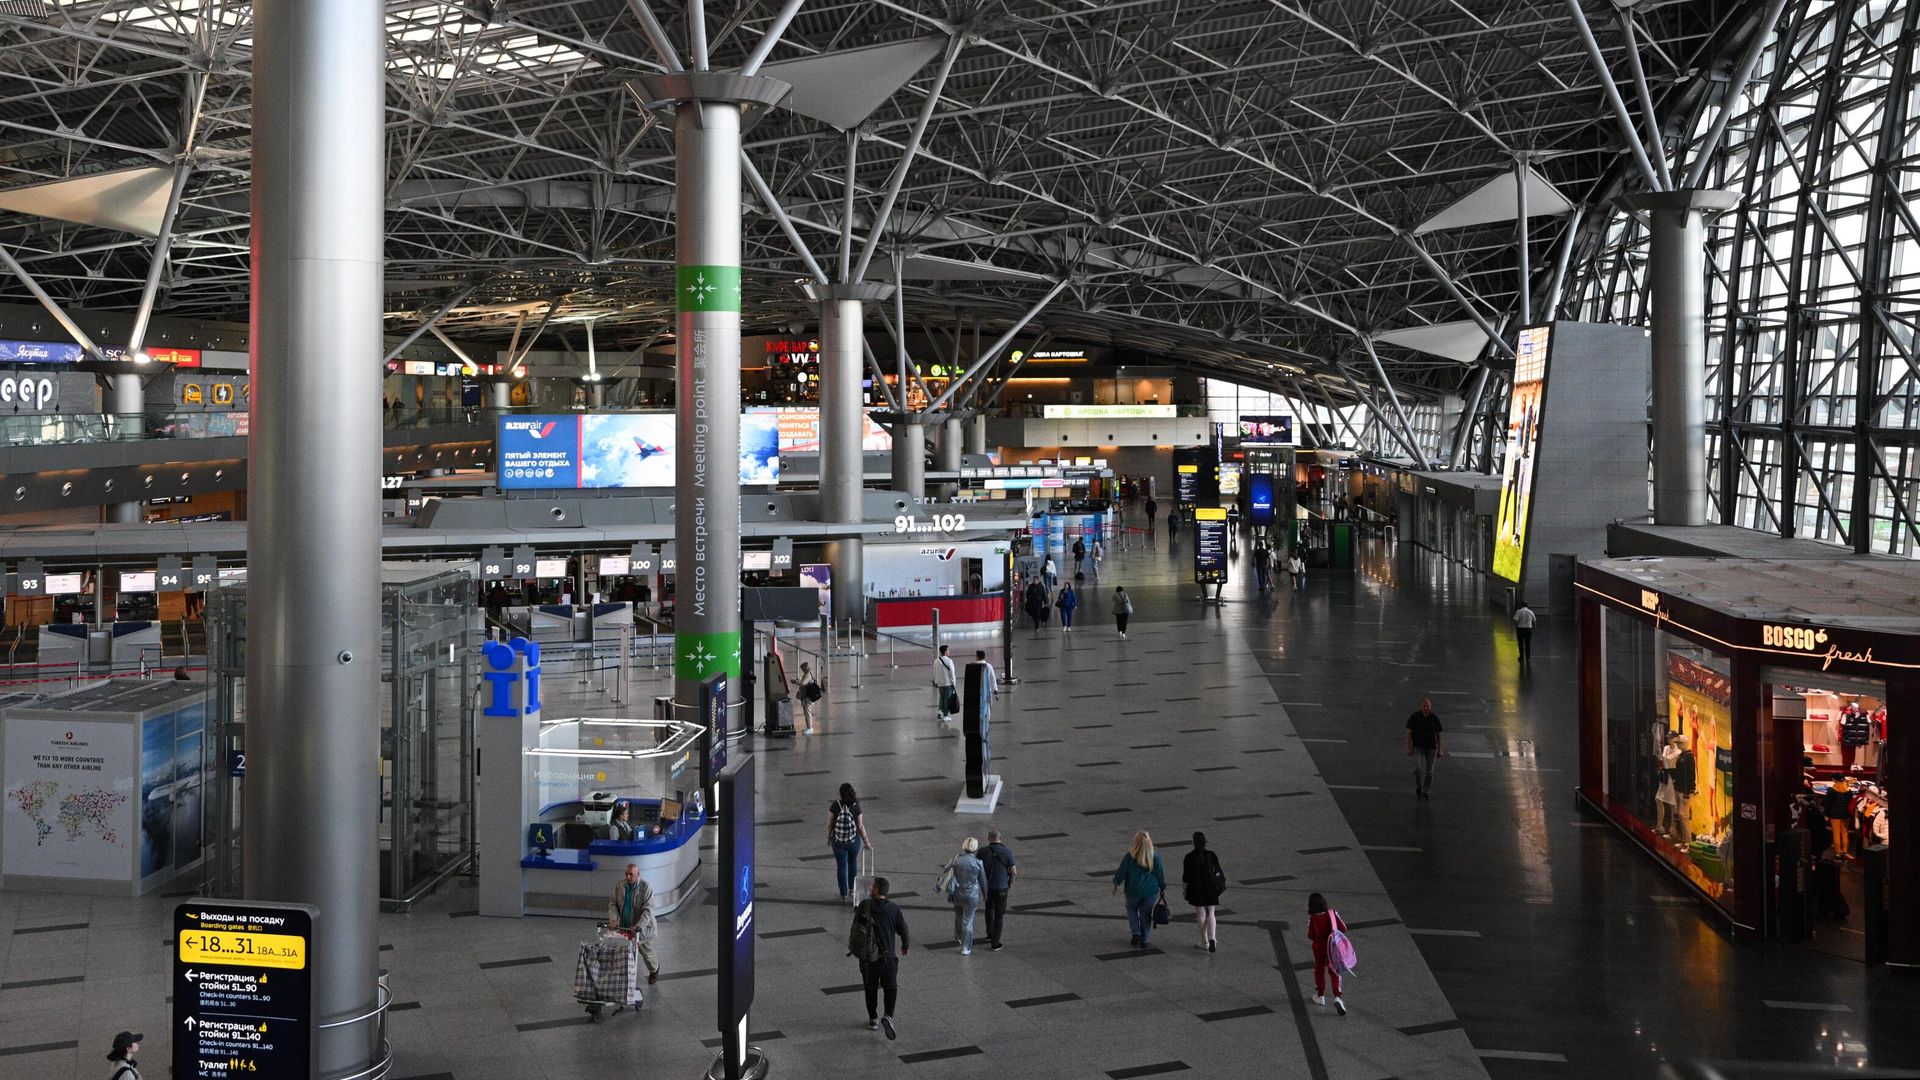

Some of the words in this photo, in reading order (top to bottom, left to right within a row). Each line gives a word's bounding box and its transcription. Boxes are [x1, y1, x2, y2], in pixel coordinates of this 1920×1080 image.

[791, 342, 807, 352] БАР
[693, 378, 708, 418] point
[505, 451, 531, 459] ПЯТЫЙ
[693, 424, 708, 487] Meeting
[696, 497, 708, 561] встречи
[774, 554, 791, 564] 102
[486, 564, 500, 574] 98
[516, 564, 530, 574] 99
[632, 560, 650, 570] 100
[22, 580, 38, 590] 93
[162, 576, 178, 586] 94
[694, 566, 705, 616] Место
[1762, 624, 1815, 650] BOSCO
[1822, 644, 1874, 672] fresh
[200, 912, 234, 922] Выходы
[249, 916, 285, 926] посадку
[200, 922, 226, 930] Boarding
[200, 936, 254, 954] 18...31
[200, 972, 256, 984] Регистрация,
[200, 982, 230, 990] стойки
[200, 1020, 256, 1032] Регистрация,
[199, 1030, 230, 1038] стойки
[198, 1060, 228, 1070] Туалет
